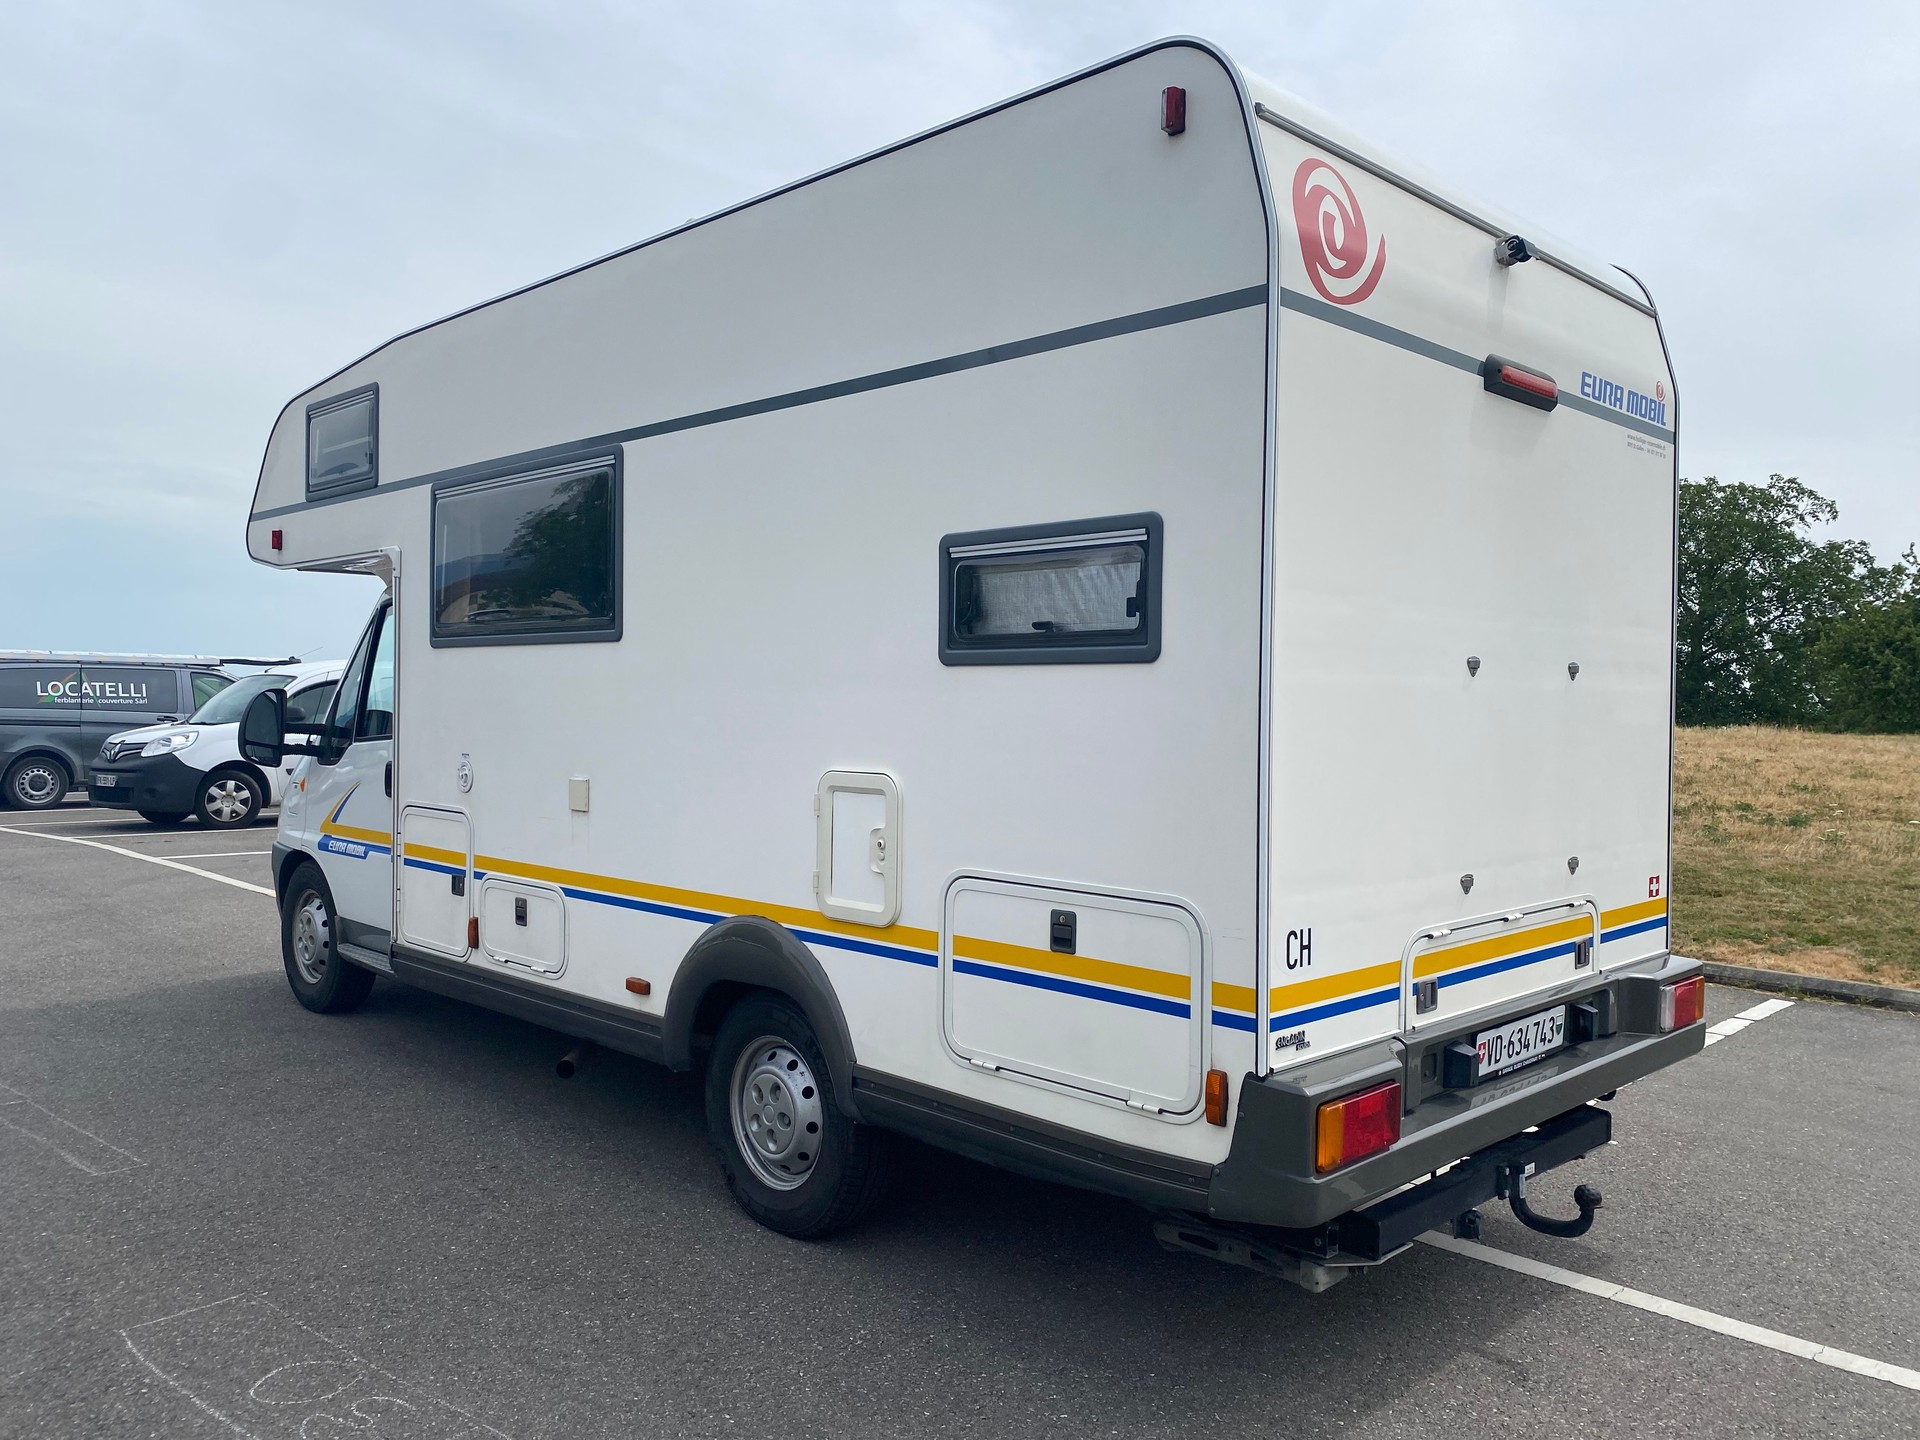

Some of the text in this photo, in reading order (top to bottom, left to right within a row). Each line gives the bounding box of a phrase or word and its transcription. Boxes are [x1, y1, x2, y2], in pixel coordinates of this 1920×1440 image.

[1580, 371, 1666, 426] EURA MOBIL
[36, 681, 147, 697] LOCATELLI
[54, 696, 94, 704] ferblanterie
[328, 840, 366, 857] EURA MOBIL
[1286, 927, 1312, 970] CH
